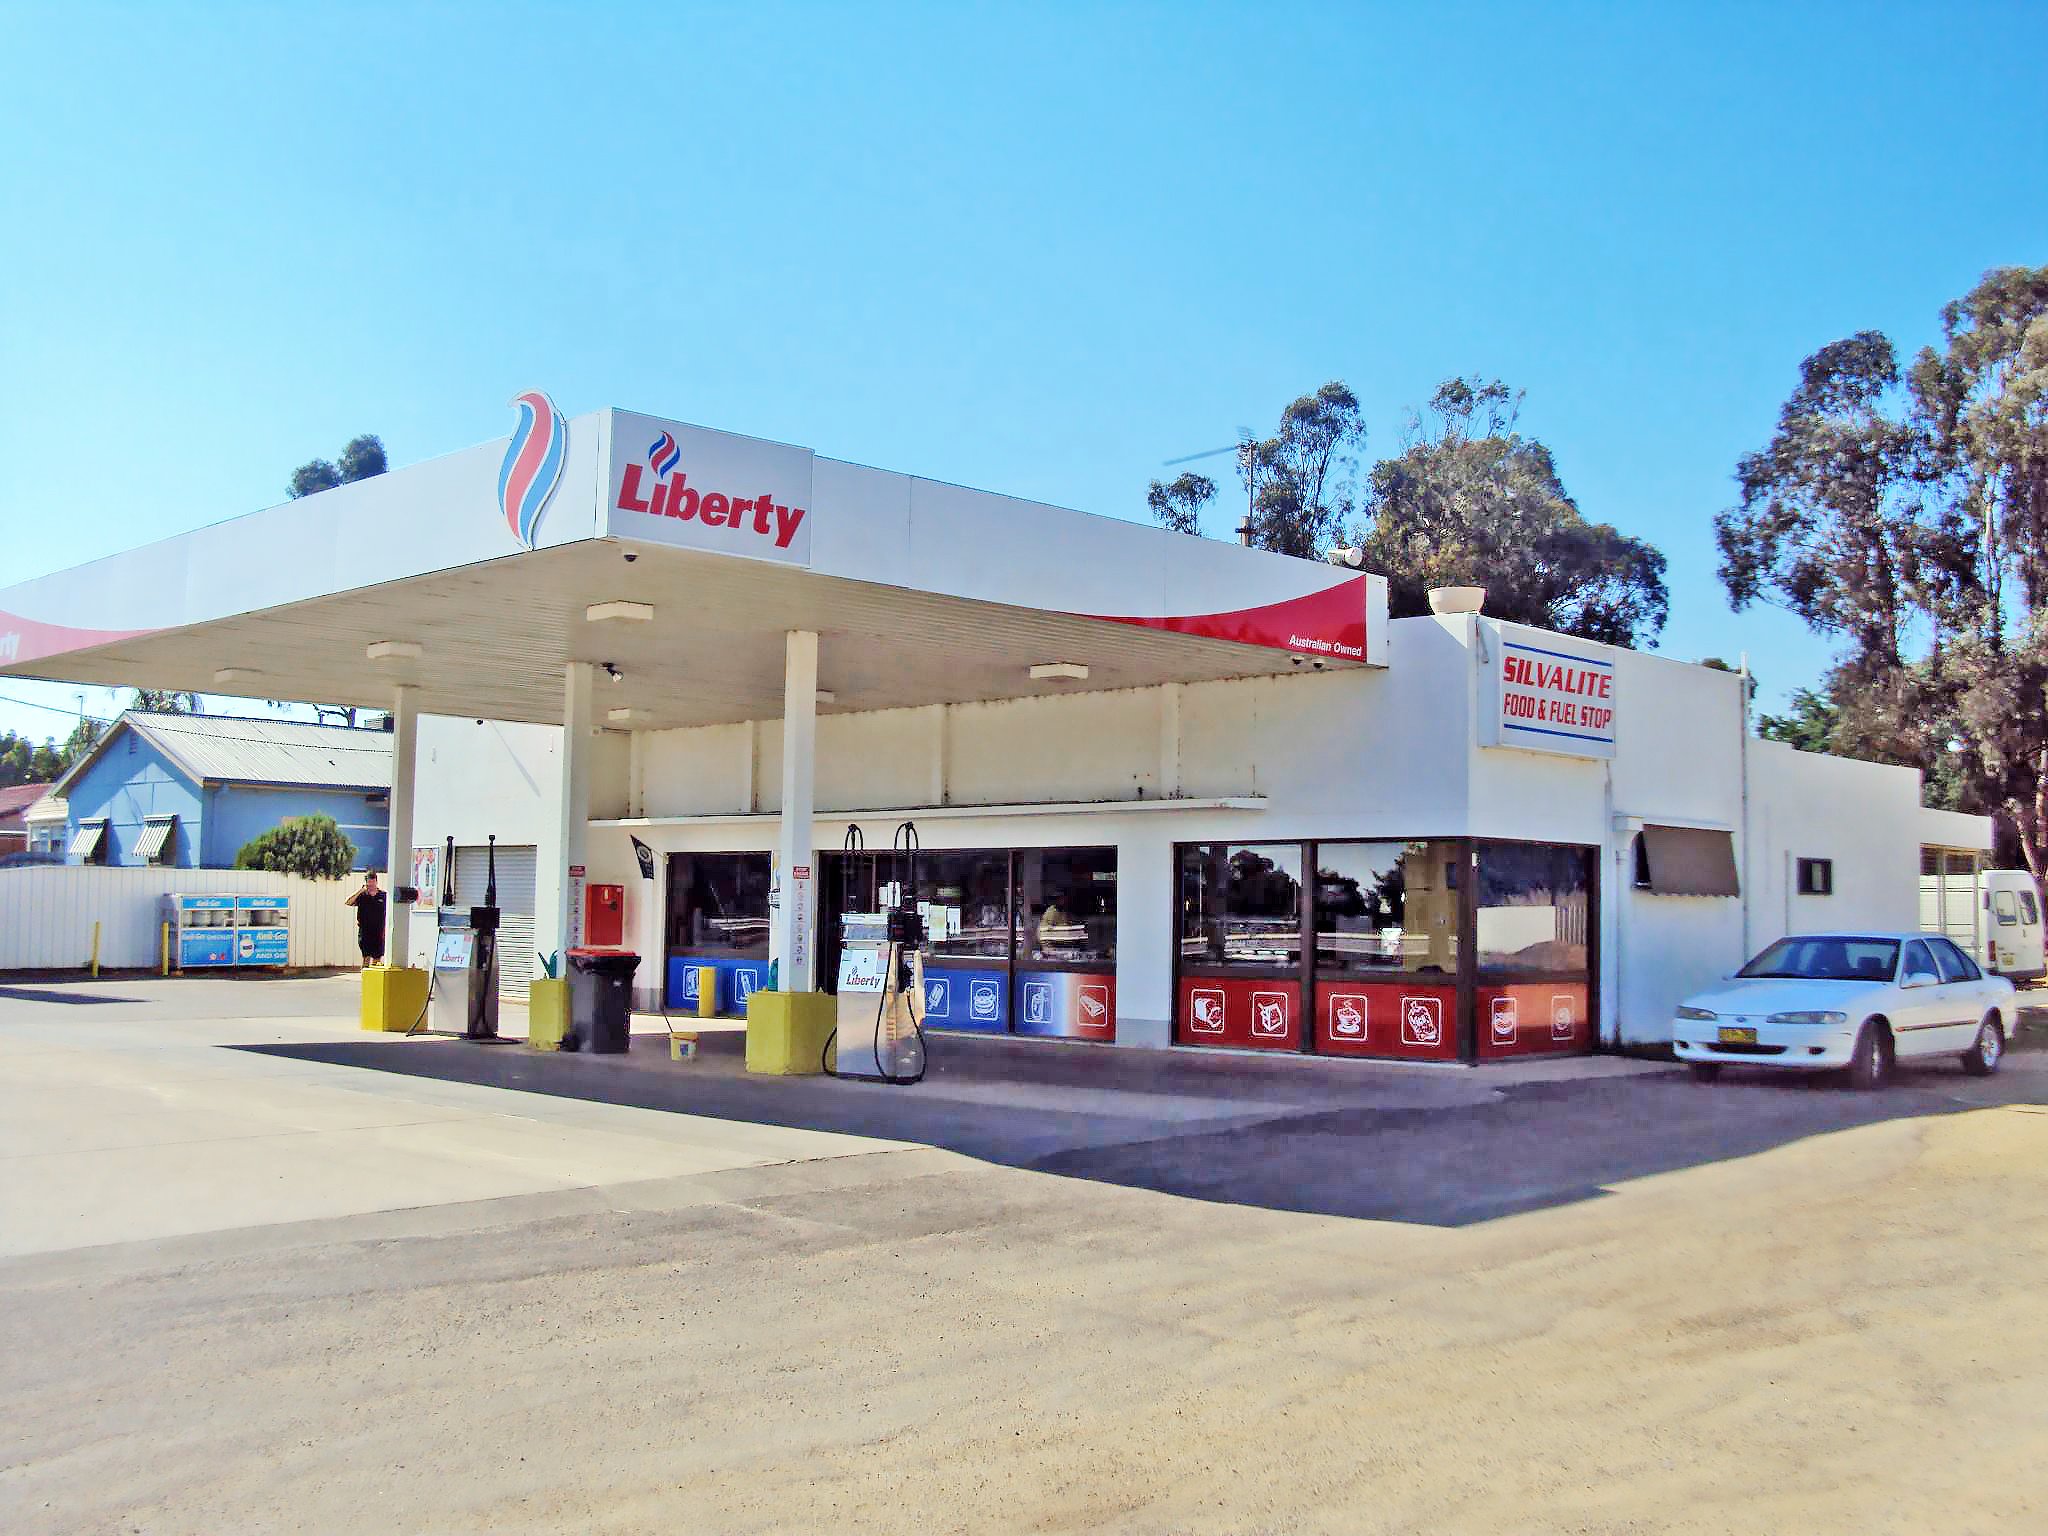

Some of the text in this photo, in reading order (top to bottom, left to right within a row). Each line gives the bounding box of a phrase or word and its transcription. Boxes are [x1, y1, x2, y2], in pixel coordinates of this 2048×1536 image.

[617, 463, 806, 548] Liberty
[1289, 633, 1362, 657] Australian Owned
[1503, 656, 1613, 699] SILVALITE
[1503, 693, 1612, 729] FOOD & FUEL STOP
[441, 952, 465, 965] Liberty
[846, 973, 881, 988] Liberty
